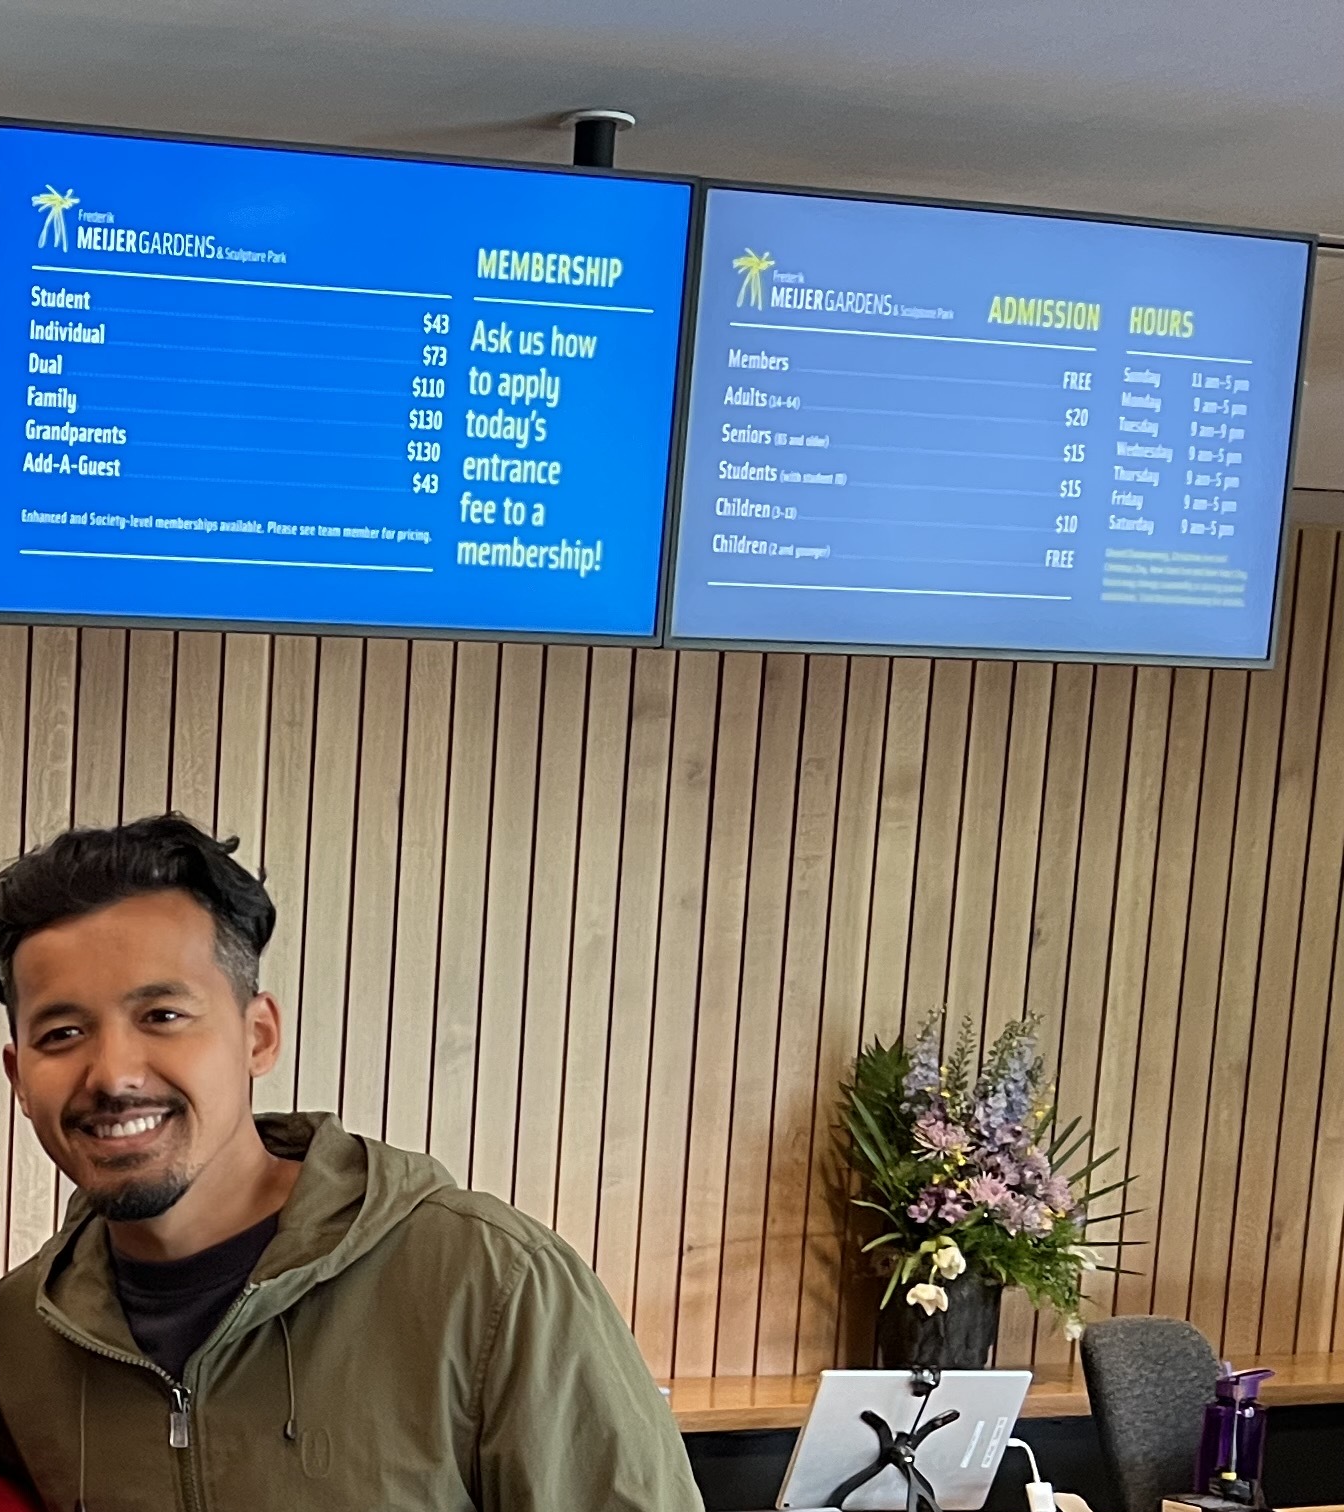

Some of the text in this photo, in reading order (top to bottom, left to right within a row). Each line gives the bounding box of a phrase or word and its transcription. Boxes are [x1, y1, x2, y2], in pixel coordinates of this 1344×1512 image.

[267, 250, 287, 264] Park
[477, 248, 623, 288] MEMBERSHIP
[31, 286, 90, 310] Student
[423, 313, 450, 334] $43
[988, 296, 1101, 331] ADMISSION
[1129, 307, 1194, 338] HOURS
[30, 319, 105, 344] Individual
[470, 319, 598, 359] Ask us how
[28, 353, 62, 375] Dual
[422, 345, 448, 367] $73
[728, 349, 789, 371] Members
[412, 377, 445, 399] $110
[469, 366, 561, 408] to apply
[1063, 371, 1092, 392] FREE
[27, 386, 77, 413] Family
[724, 386, 768, 407] Adults
[409, 409, 443, 431] $130
[465, 408, 547, 449] today's
[1065, 408, 1089, 428] $20
[25, 419, 127, 446] Grandparents
[722, 423, 772, 444] Seniors
[407, 440, 441, 462] $130
[1063, 444, 1086, 463] $15
[23, 452, 121, 477] Add-A-Guest
[462, 452, 561, 485] entrance
[719, 460, 778, 481] Students
[412, 473, 439, 494] $43
[1060, 480, 1082, 499] $15
[460, 491, 545, 527] fee to a
[716, 497, 771, 518] Children
[21, 509, 67, 524] Enhanced
[69, 512, 88, 525] and
[89, 512, 153, 529] Society-level
[155, 517, 218, 533] memberships
[267, 521, 297, 535] Please
[299, 525, 316, 536] see
[317, 525, 341, 537] team
[342, 526, 380, 539] member
[381, 527, 396, 540] for
[1055, 515, 1078, 534] $10
[712, 533, 768, 555] Children
[456, 536, 603, 578] membership!
[1045, 550, 1075, 569] FREE
